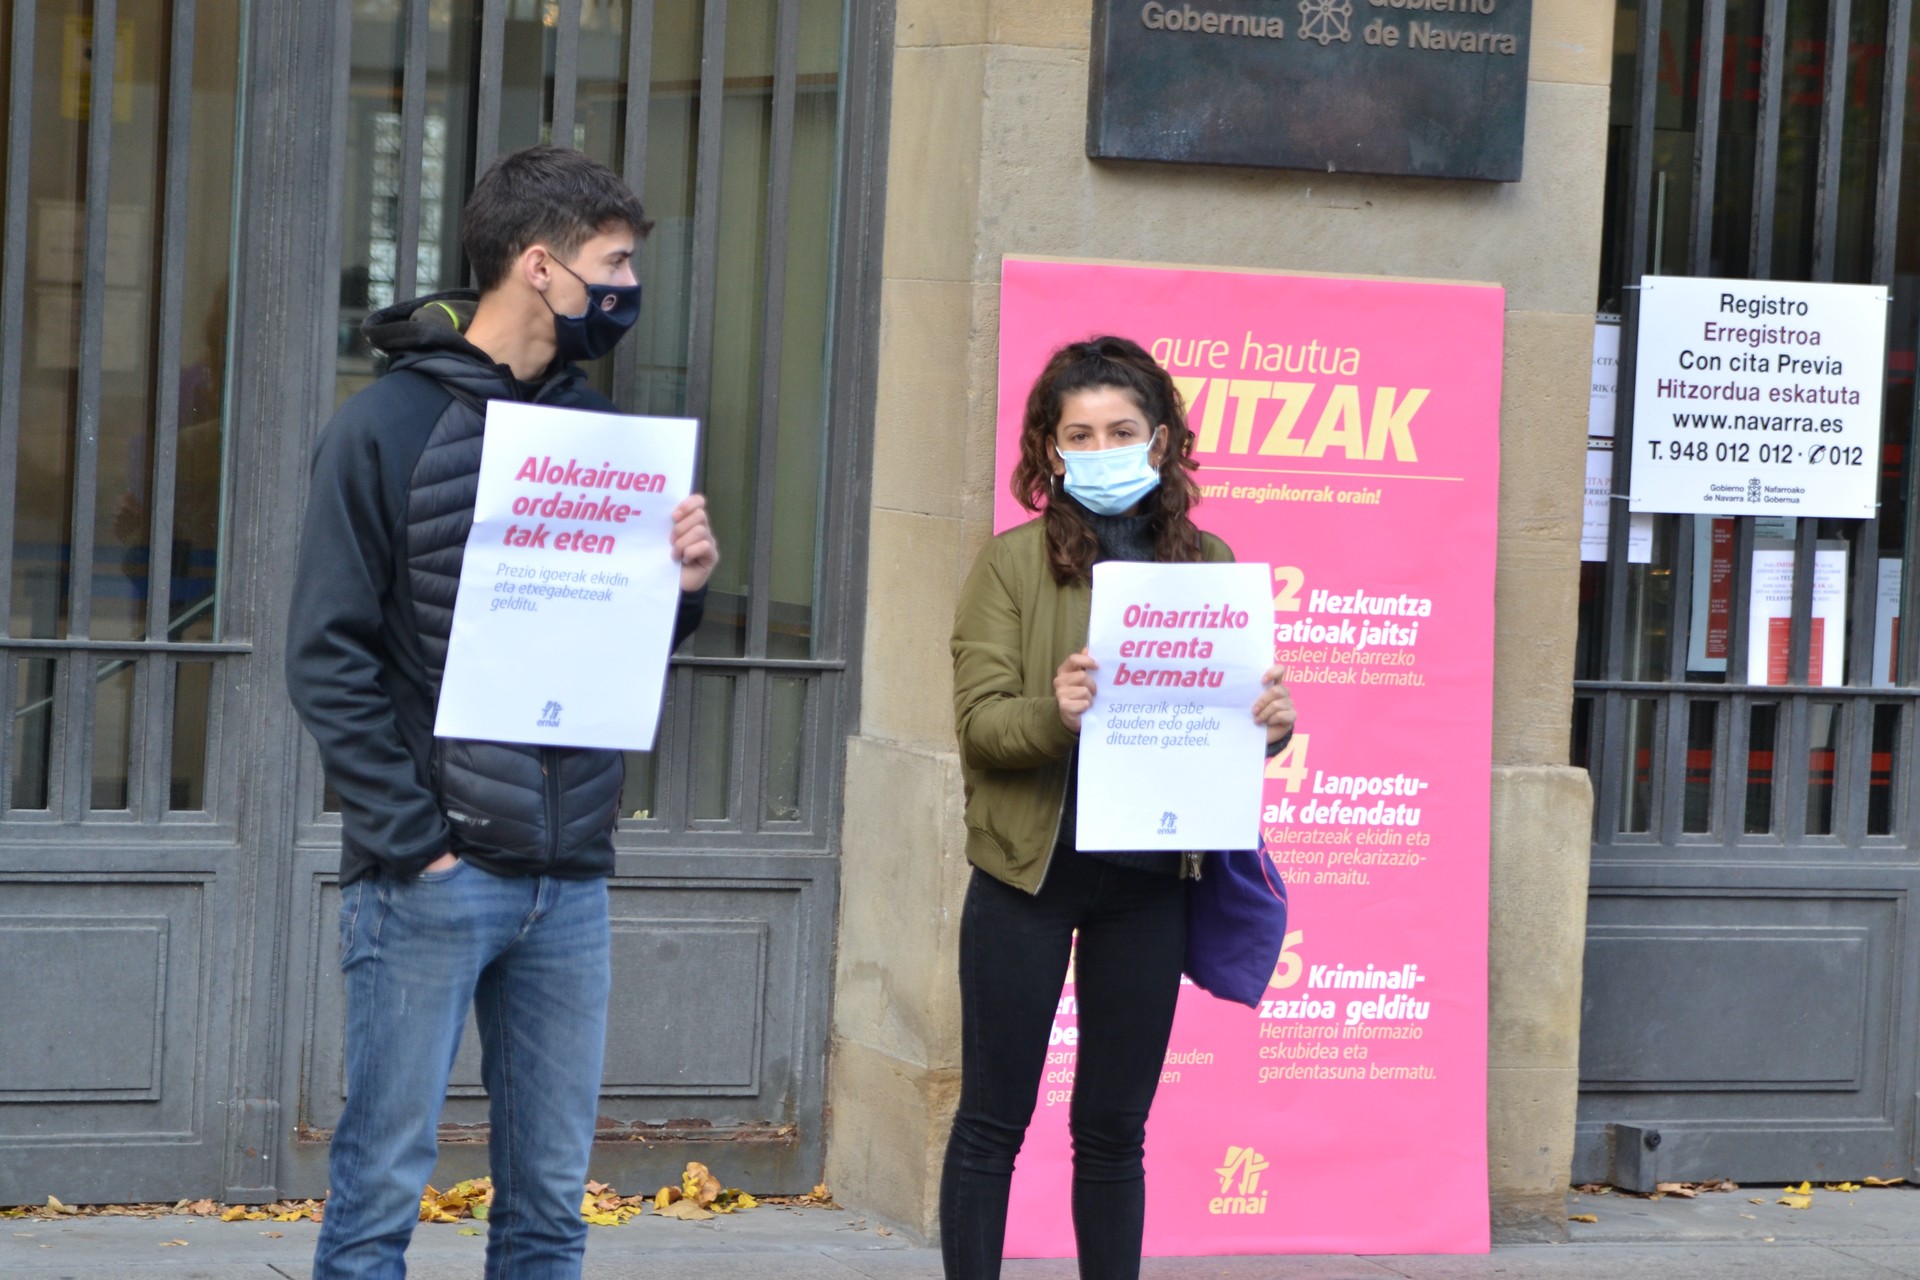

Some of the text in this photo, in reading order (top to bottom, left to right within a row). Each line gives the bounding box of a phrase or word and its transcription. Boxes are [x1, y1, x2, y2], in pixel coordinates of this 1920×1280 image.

[1141, 1, 1284, 39] Gobernua
[1364, 18, 1517, 55] de Navarra
[1719, 293, 1808, 319] Registro
[1704, 322, 1821, 348] Erregistroa
[1151, 331, 1360, 376] gure hautua
[1679, 350, 1842, 376] Con cita Previa
[1657, 379, 1860, 405] Hitzordua eskatuta
[1673, 412, 1843, 433] www.navarra.es
[1648, 440, 1863, 466] T. 948 012 012 012
[515, 456, 667, 493] Alokairuen
[1201, 481, 1381, 504] urri eraginkorrak orain!
[1704, 494, 1744, 503] de Navarra
[1710, 484, 1744, 492] Gobierno
[1764, 486, 1805, 494] Nafarroako
[1764, 496, 1800, 504] Gobernua
[512, 492, 641, 523] ordainke-
[503, 524, 616, 554] tak eten
[496, 562, 629, 587] Prezio igoerak ekidin
[494, 581, 612, 602] eta etxegabetzeak
[1274, 566, 1305, 612] 2
[490, 597, 538, 613] gelditu.
[1122, 602, 1249, 629] Oinarrizko
[1308, 589, 1432, 617] Hezkuntza
[1357, 619, 1418, 650] jaitsi
[1119, 637, 1213, 659] errenta
[1274, 644, 1415, 666] kasleei beharrezko
[1113, 663, 1225, 688] bermatu
[1283, 665, 1426, 687] liabideak bermatu.
[1107, 701, 1204, 717] sarrerarik gabe
[1106, 716, 1220, 734] dauden edo galdu
[1106, 732, 1210, 749] dituzten gazteei.
[1264, 733, 1310, 793] 4
[1313, 770, 1428, 801] Lanpostu-
[1263, 798, 1421, 826] ak defendatu
[1264, 826, 1431, 846] Kaleratzeak ekidin eta
[1328, 848, 1426, 868] prekarizazio-
[1280, 867, 1370, 886] ekin amaitu.
[1268, 929, 1303, 989] 6
[1308, 963, 1426, 989] Kriminali-
[1259, 993, 1430, 1025] zazioa gelditu
[1260, 1022, 1423, 1040] Herritarroi informazio
[1259, 1042, 1368, 1060] eskubidea eta
[1258, 1062, 1437, 1083] gardentasuna bermatu.
[1209, 1190, 1268, 1214] ernai
